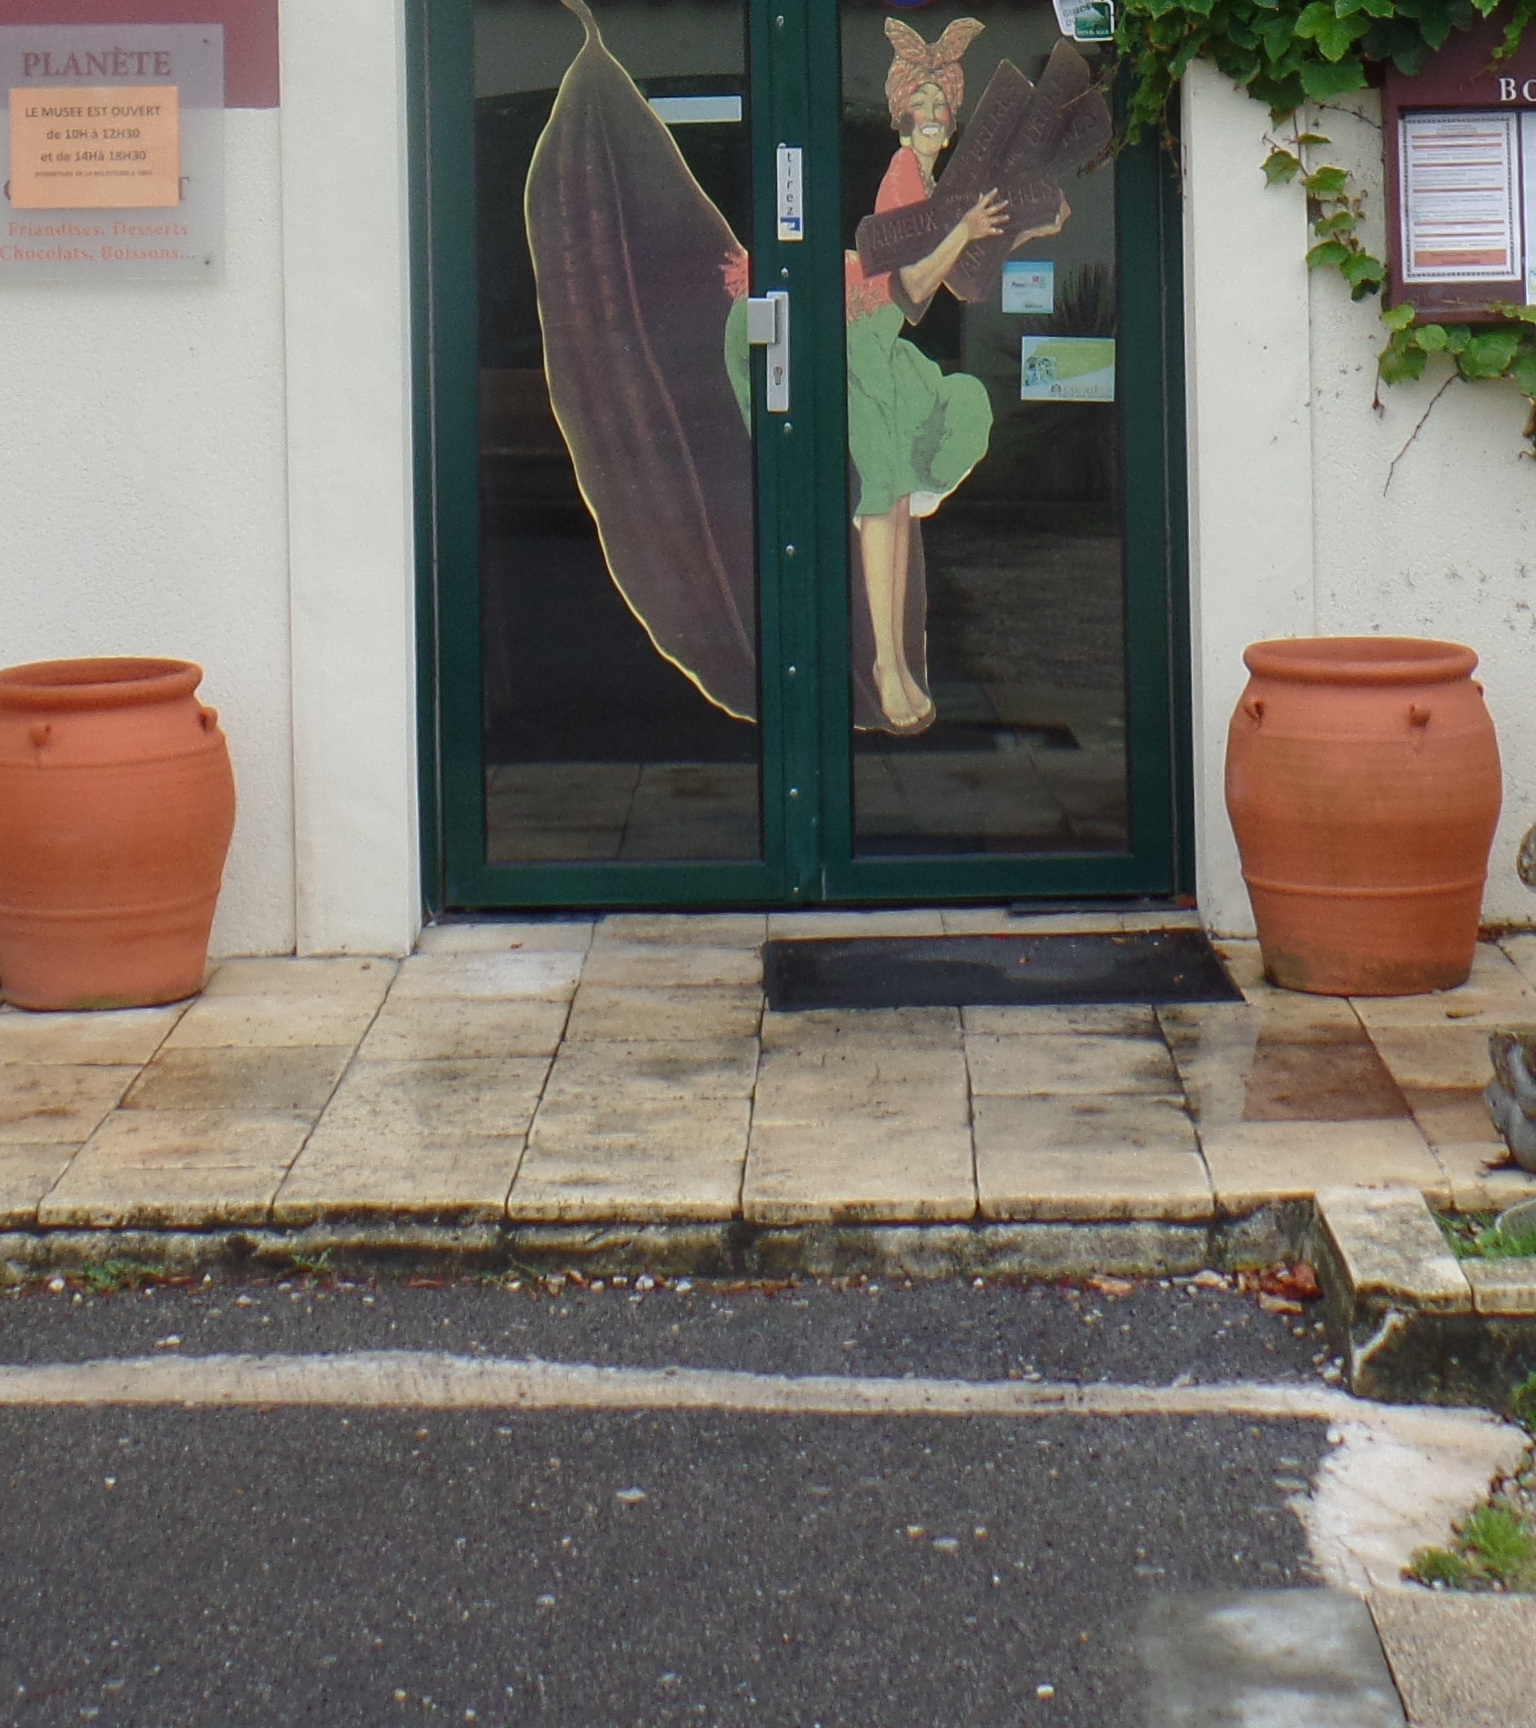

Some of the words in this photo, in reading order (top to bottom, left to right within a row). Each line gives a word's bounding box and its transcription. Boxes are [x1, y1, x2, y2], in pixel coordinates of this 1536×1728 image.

[22, 46, 172, 78] PLANÈTE
[25, 106, 38, 118] LE
[41, 106, 83, 118] MUSEE
[87, 106, 107, 117] EST
[111, 105, 162, 117] OUVERT
[46, 129, 61, 140] de
[65, 129, 88, 140] 10H
[91, 129, 99, 139] à
[102, 128, 141, 139] 12H30
[41, 152, 53, 162] et
[56, 151, 71, 162] de
[109, 150, 147, 162] 18H30
[112, 222, 189, 236] Desserts
